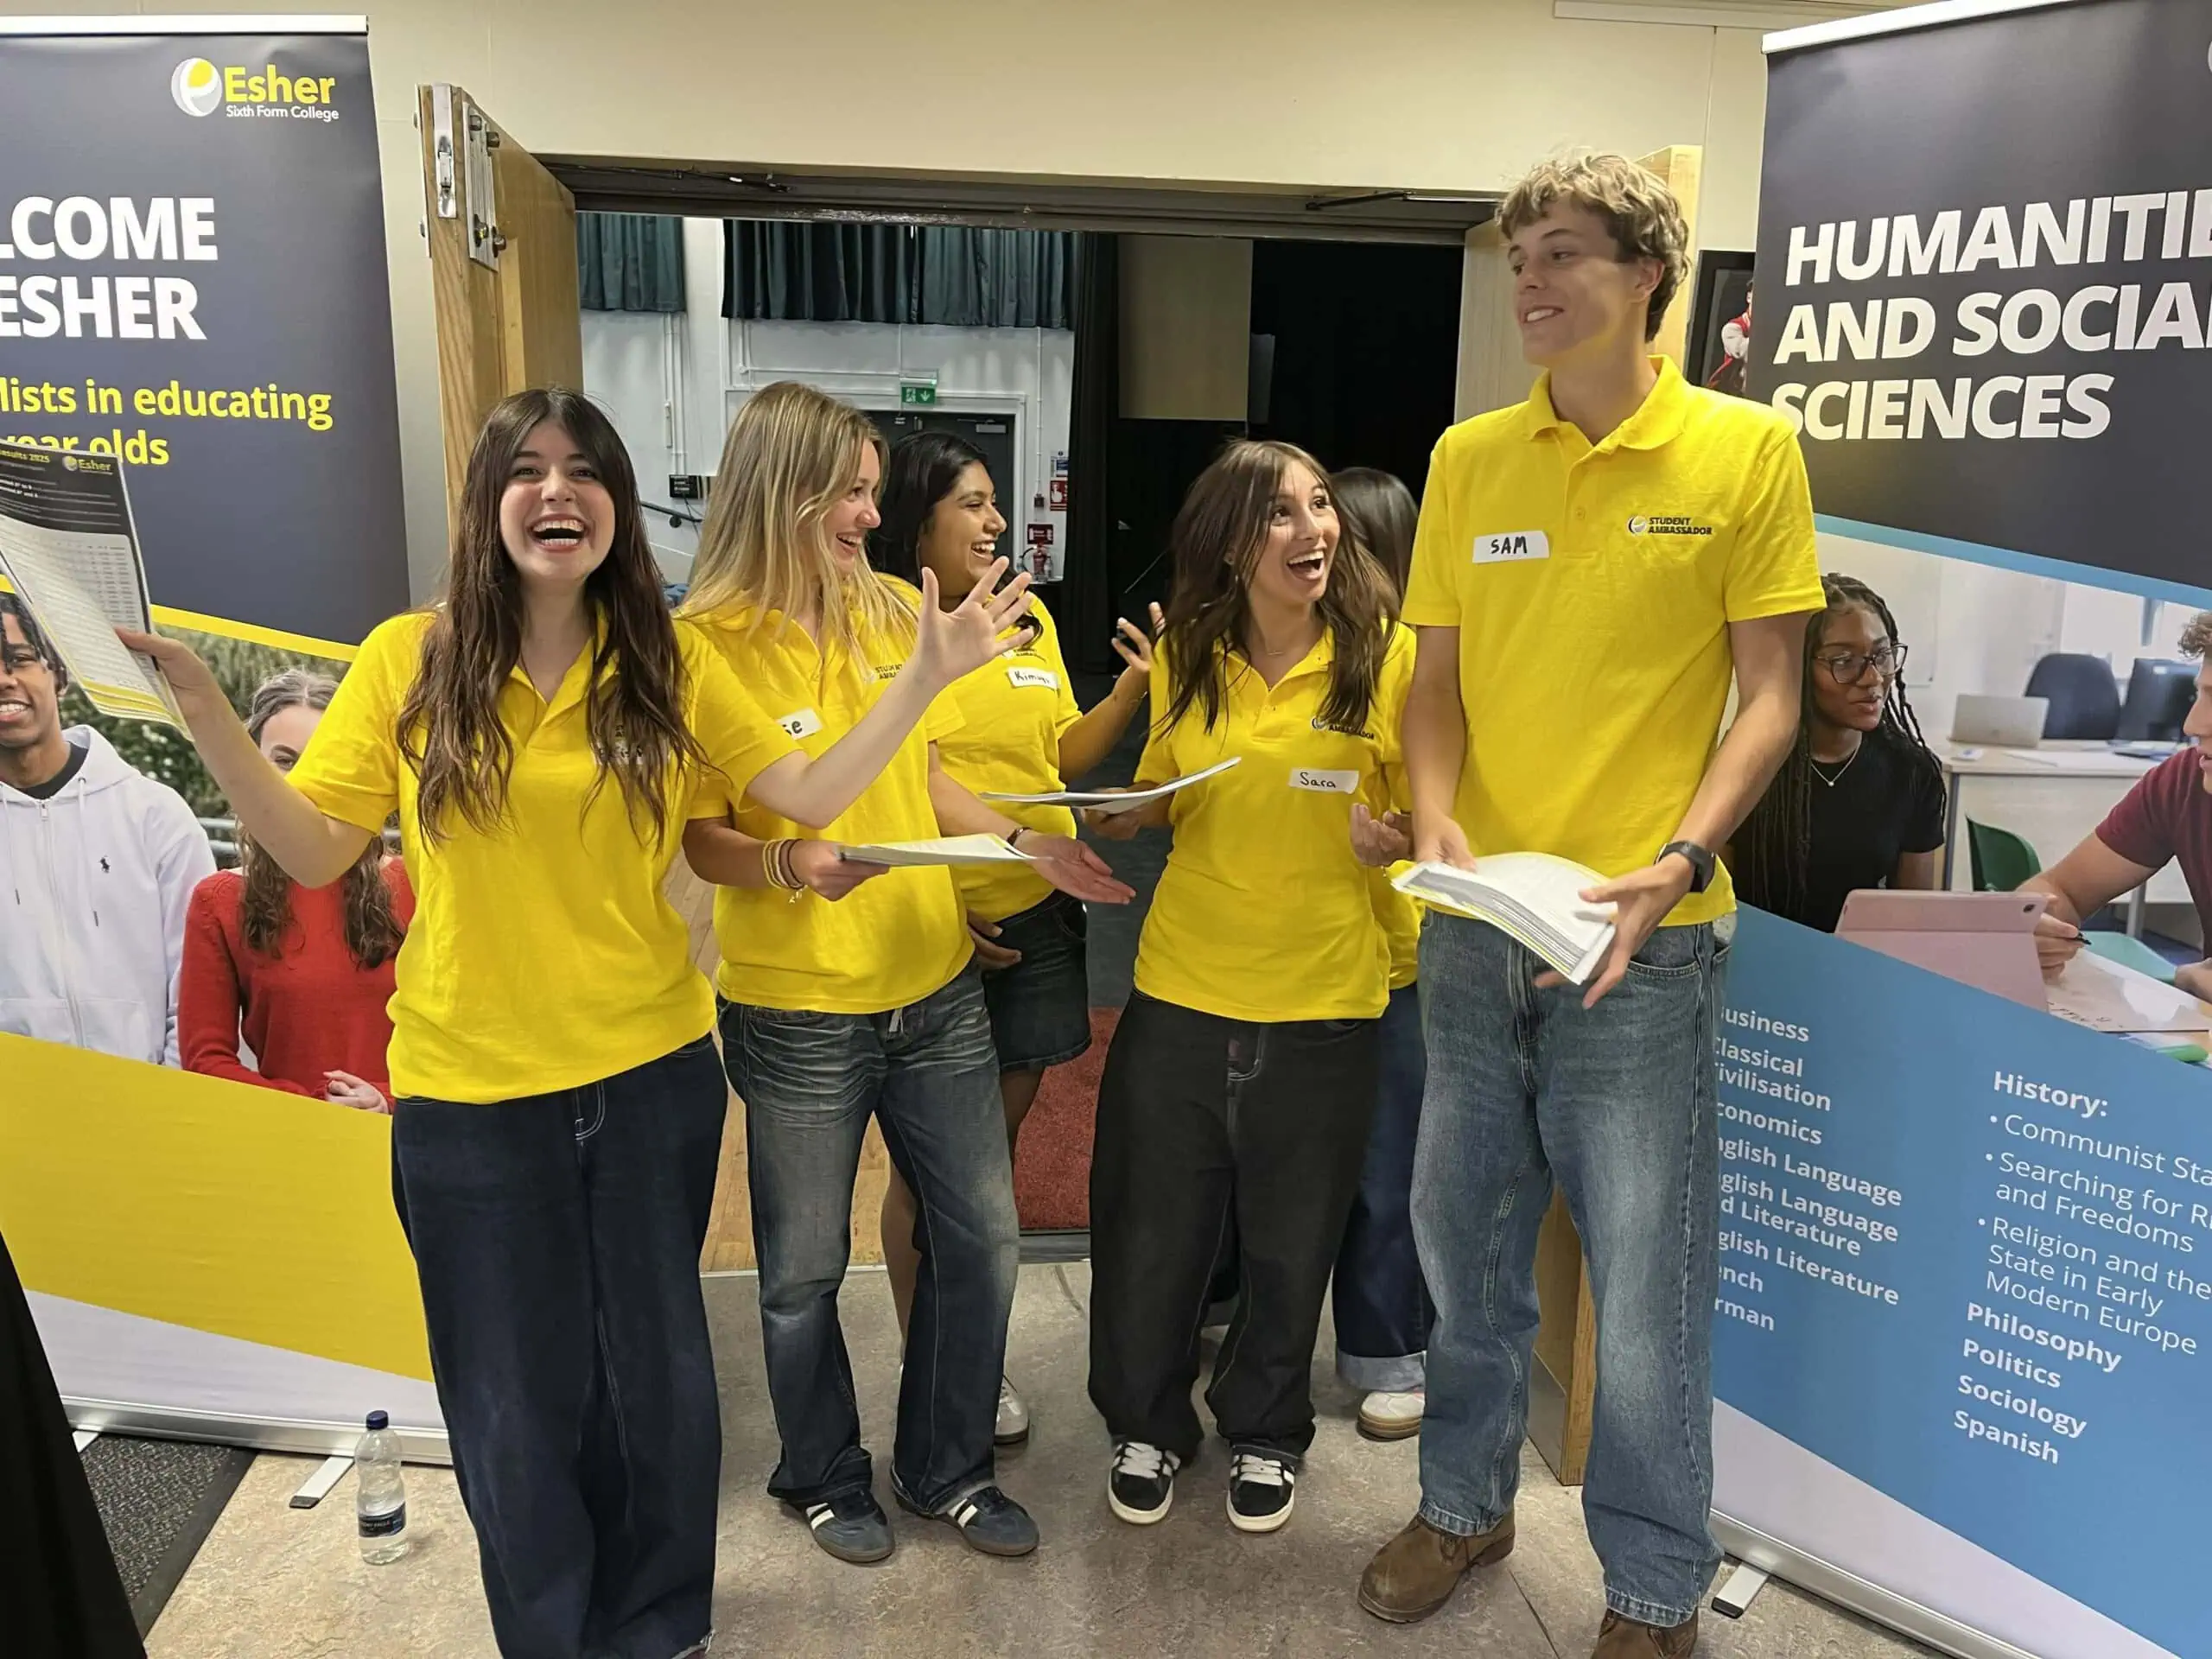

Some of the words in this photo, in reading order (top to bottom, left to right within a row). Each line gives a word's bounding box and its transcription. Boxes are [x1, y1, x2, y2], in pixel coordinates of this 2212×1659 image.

[224, 64, 336, 105] Esher
[226, 105, 255, 118] Sixth
[257, 105, 288, 118] Form
[290, 106, 339, 123] College
[1772, 297, 1936, 365] AND
[1952, 282, 2212, 356] SOCIA
[86, 378, 123, 415] in
[134, 380, 334, 430] educating
[1770, 373, 2114, 441] SCIENCES
[1491, 536, 1528, 554] SAM
[1649, 517, 1692, 525] STUDENT
[1649, 525, 1713, 535] AMBASSADOR
[1300, 772, 1337, 788] Sara
[1721, 1007, 1810, 1042] usiness
[1715, 1062, 1832, 1111] ivilisation
[1993, 1071, 2108, 1119] History:
[2005, 1114, 2165, 1173] Communist
[1719, 1173, 1774, 1203] glish
[1781, 1188, 1898, 1242] Language
[1783, 1154, 1902, 1206] Language
[1999, 1152, 2134, 1211] Searching
[2142, 1189, 2183, 1217] for
[1741, 1201, 1861, 1256] Literature
[1996, 1184, 2047, 1211] and
[2056, 1195, 2195, 1253] Freedoms
[1776, 1247, 1900, 1306] Literature
[1988, 1244, 2055, 1281] State
[2063, 1266, 2087, 1291] in
[2096, 1275, 2164, 1318] Early
[1993, 1217, 2097, 1265] Religion
[2105, 1255, 2158, 1283] and
[2166, 1269, 2212, 1300] the
[1967, 1302, 2122, 1372] Philosophy
[1986, 1270, 2089, 1321] Modern
[2099, 1306, 2197, 1355] Europe
[1963, 1338, 2061, 1388] Politics
[1957, 1375, 2087, 1439] Sociology
[1954, 1410, 2059, 1465] Spanish
